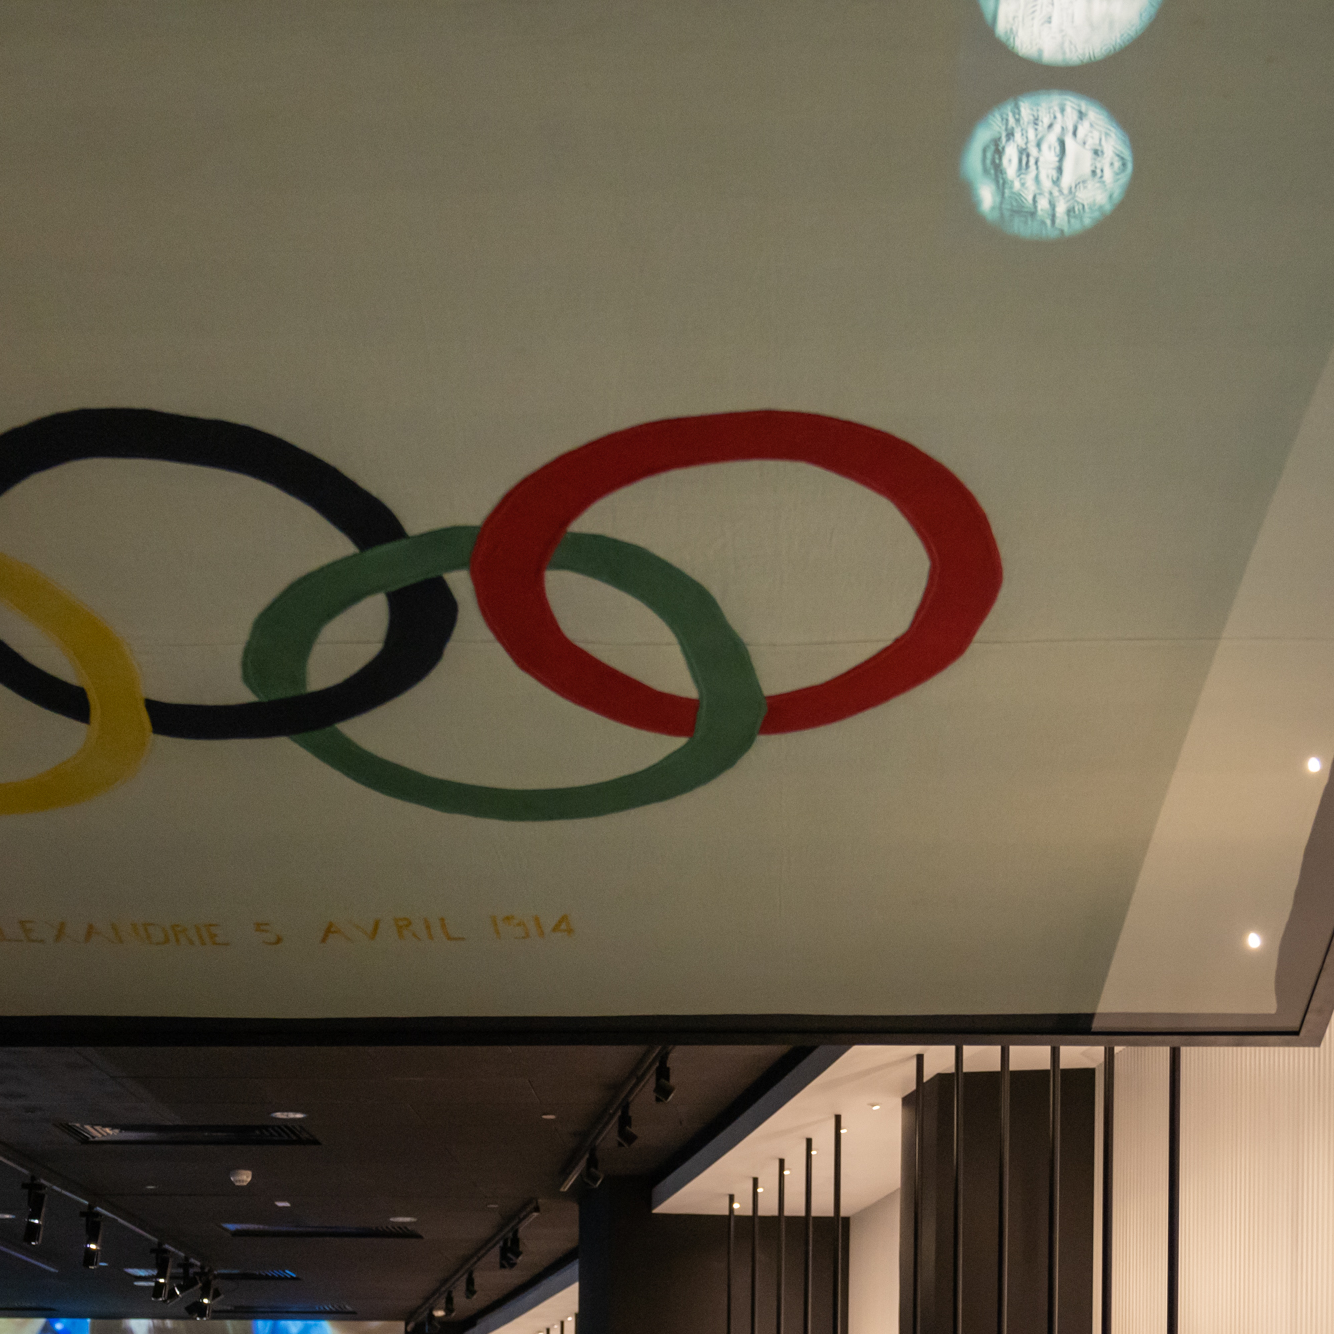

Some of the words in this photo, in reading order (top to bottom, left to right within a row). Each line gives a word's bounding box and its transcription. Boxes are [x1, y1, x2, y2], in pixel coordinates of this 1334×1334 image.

[253, 921, 285, 946] 5
[320, 915, 466, 944] AVRIL
[489, 914, 575, 940] 1914
